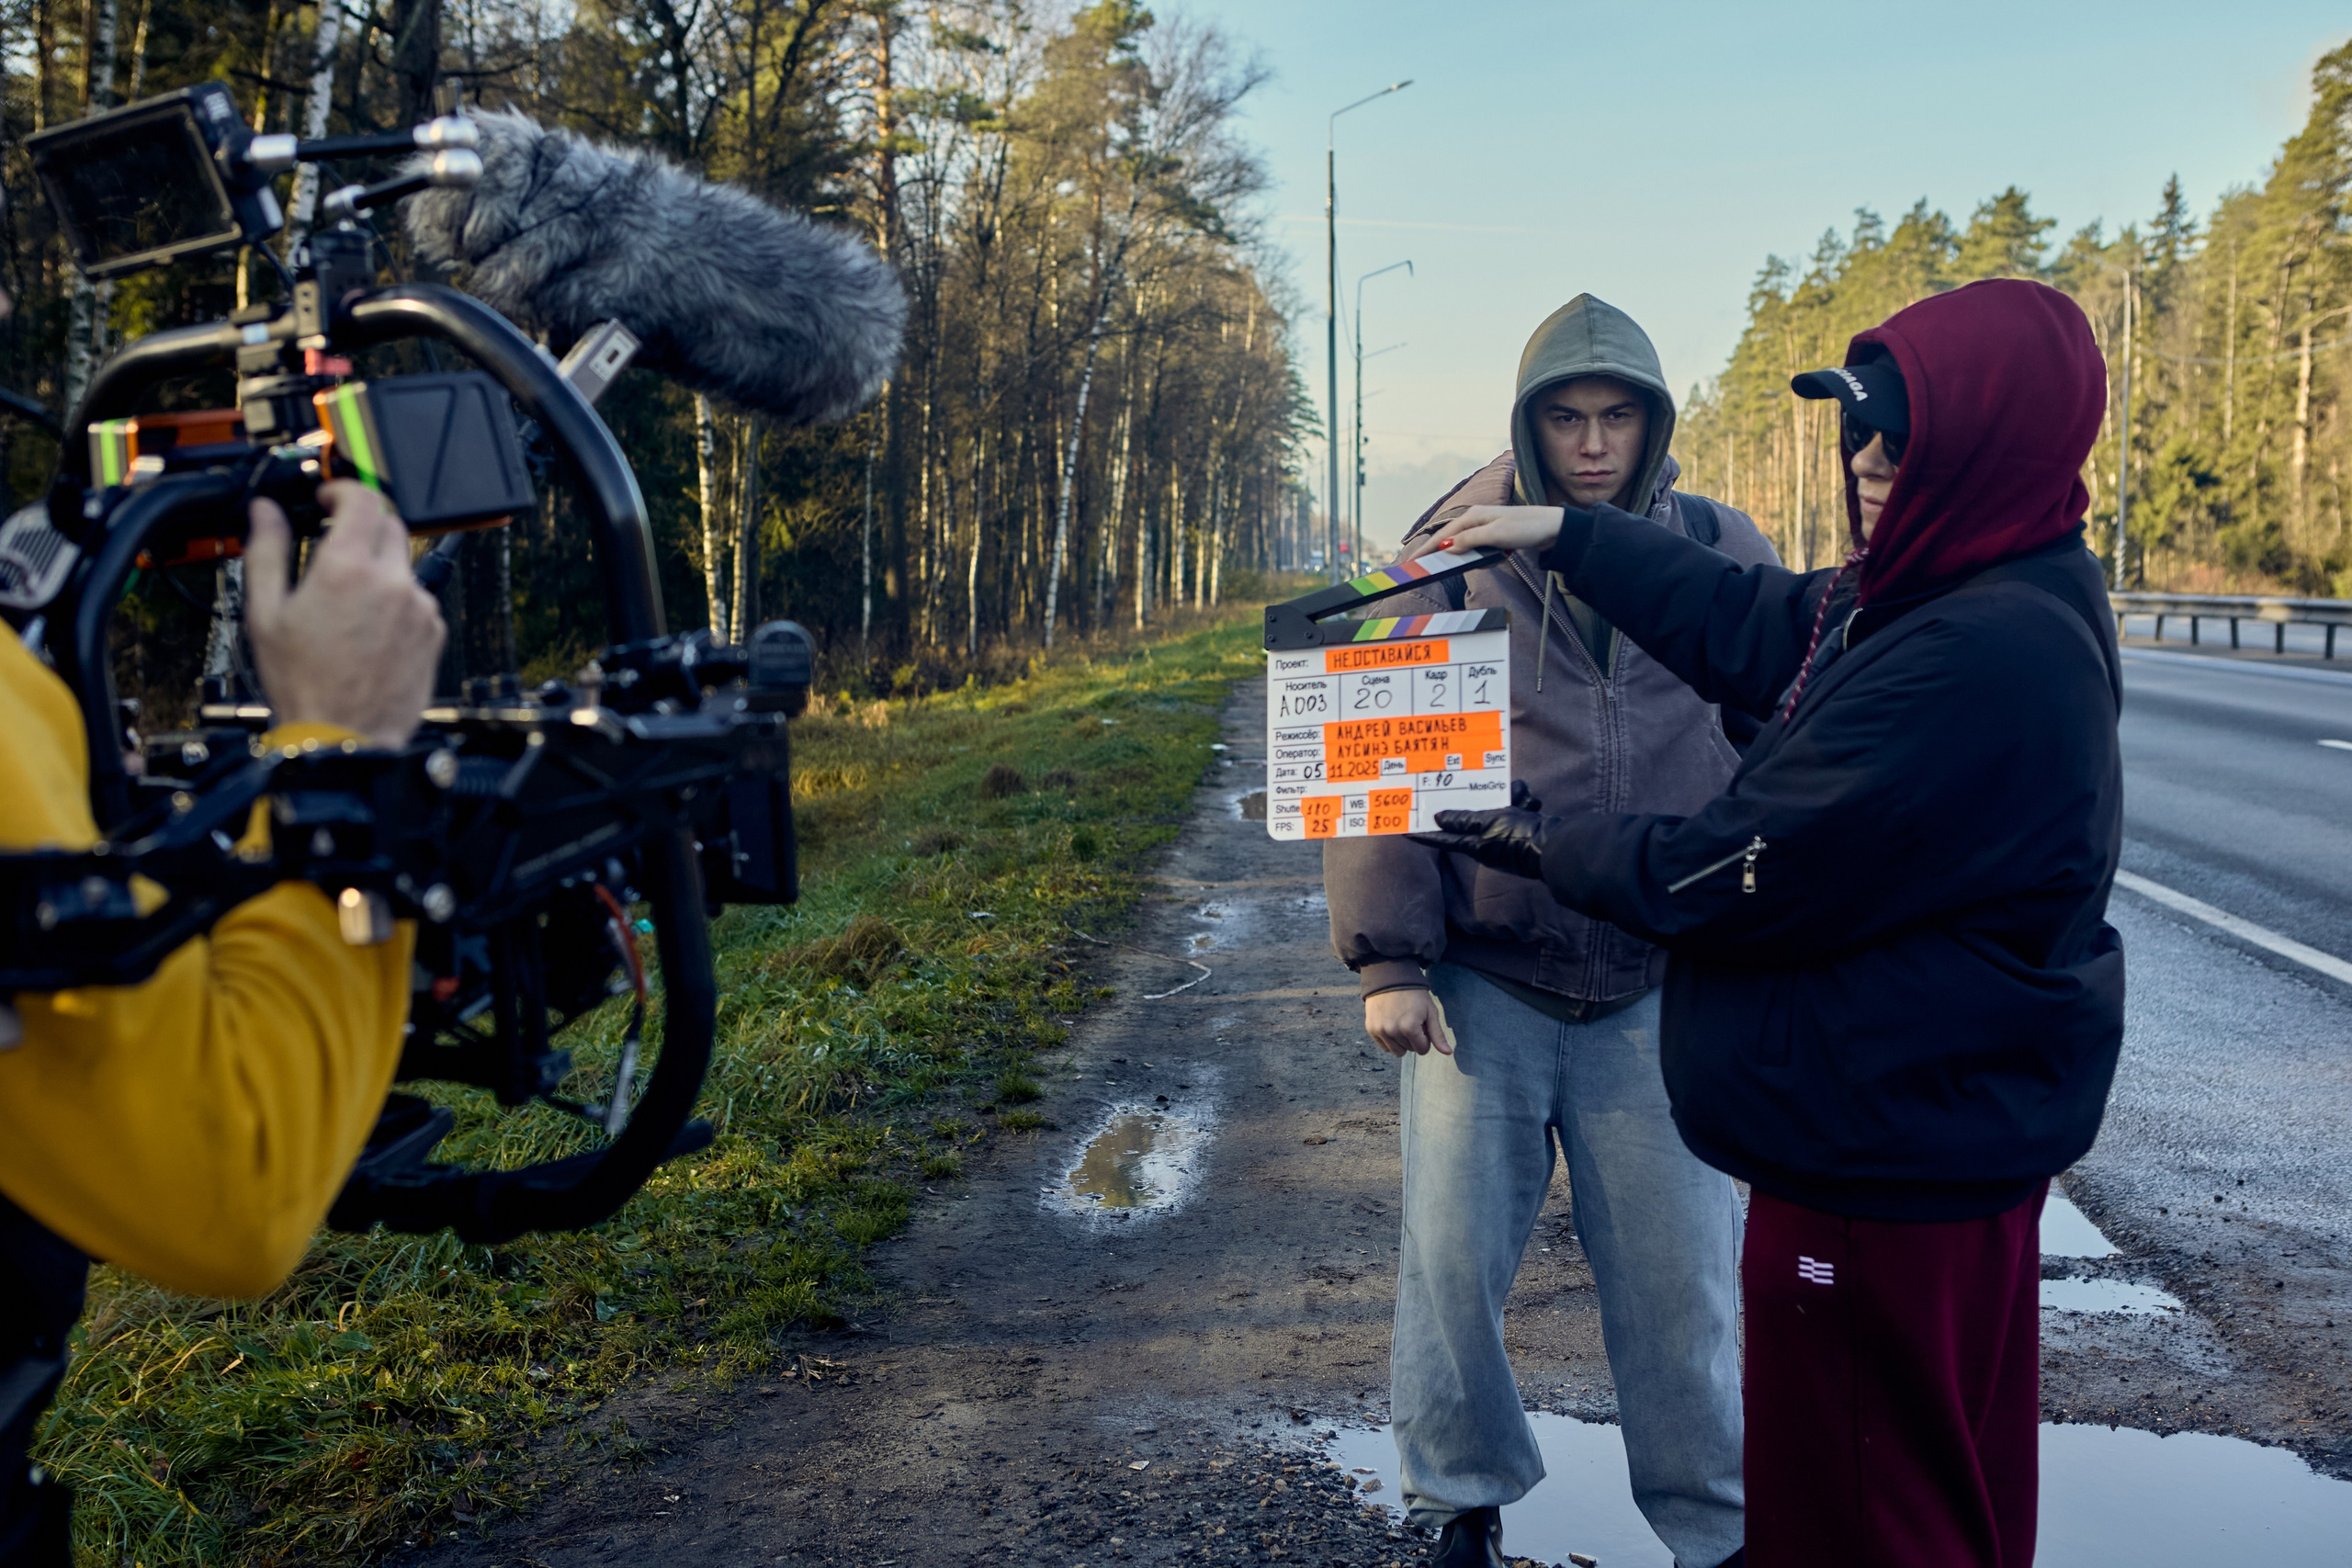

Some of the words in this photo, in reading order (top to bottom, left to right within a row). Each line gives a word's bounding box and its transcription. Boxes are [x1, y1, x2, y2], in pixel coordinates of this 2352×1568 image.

[1275, 659, 1309, 671] Проект:
[1425, 670, 1448, 681] Кадр
[1467, 665, 1498, 679] Дубль
[1285, 681, 1328, 692] Носитель
[1362, 675, 1390, 686] Сцена
[1354, 687, 1393, 709] 20
[1430, 683, 1447, 707] 2
[1473, 680, 1491, 705] 1
[1275, 728, 1321, 741] Режиссёр:
[1337, 719, 1391, 741] АНДРЕЙ
[1398, 717, 1467, 736] ВАСИЛЬЕВ
[1394, 736, 1450, 754] БАЯТЯН
[1275, 748, 1321, 760] Оператор:
[1485, 752, 1506, 764] Sync
[1304, 762, 1325, 779] 05
[1384, 760, 1405, 771] День
[1275, 767, 1298, 779] Дата:
[1275, 785, 1307, 795] Фильтр:
[1350, 799, 1366, 809] WB:
[1374, 794, 1410, 807] 5600
[1275, 822, 1295, 832] FPS:
[1312, 818, 1331, 833] 25
[1349, 818, 1367, 828] ISO:
